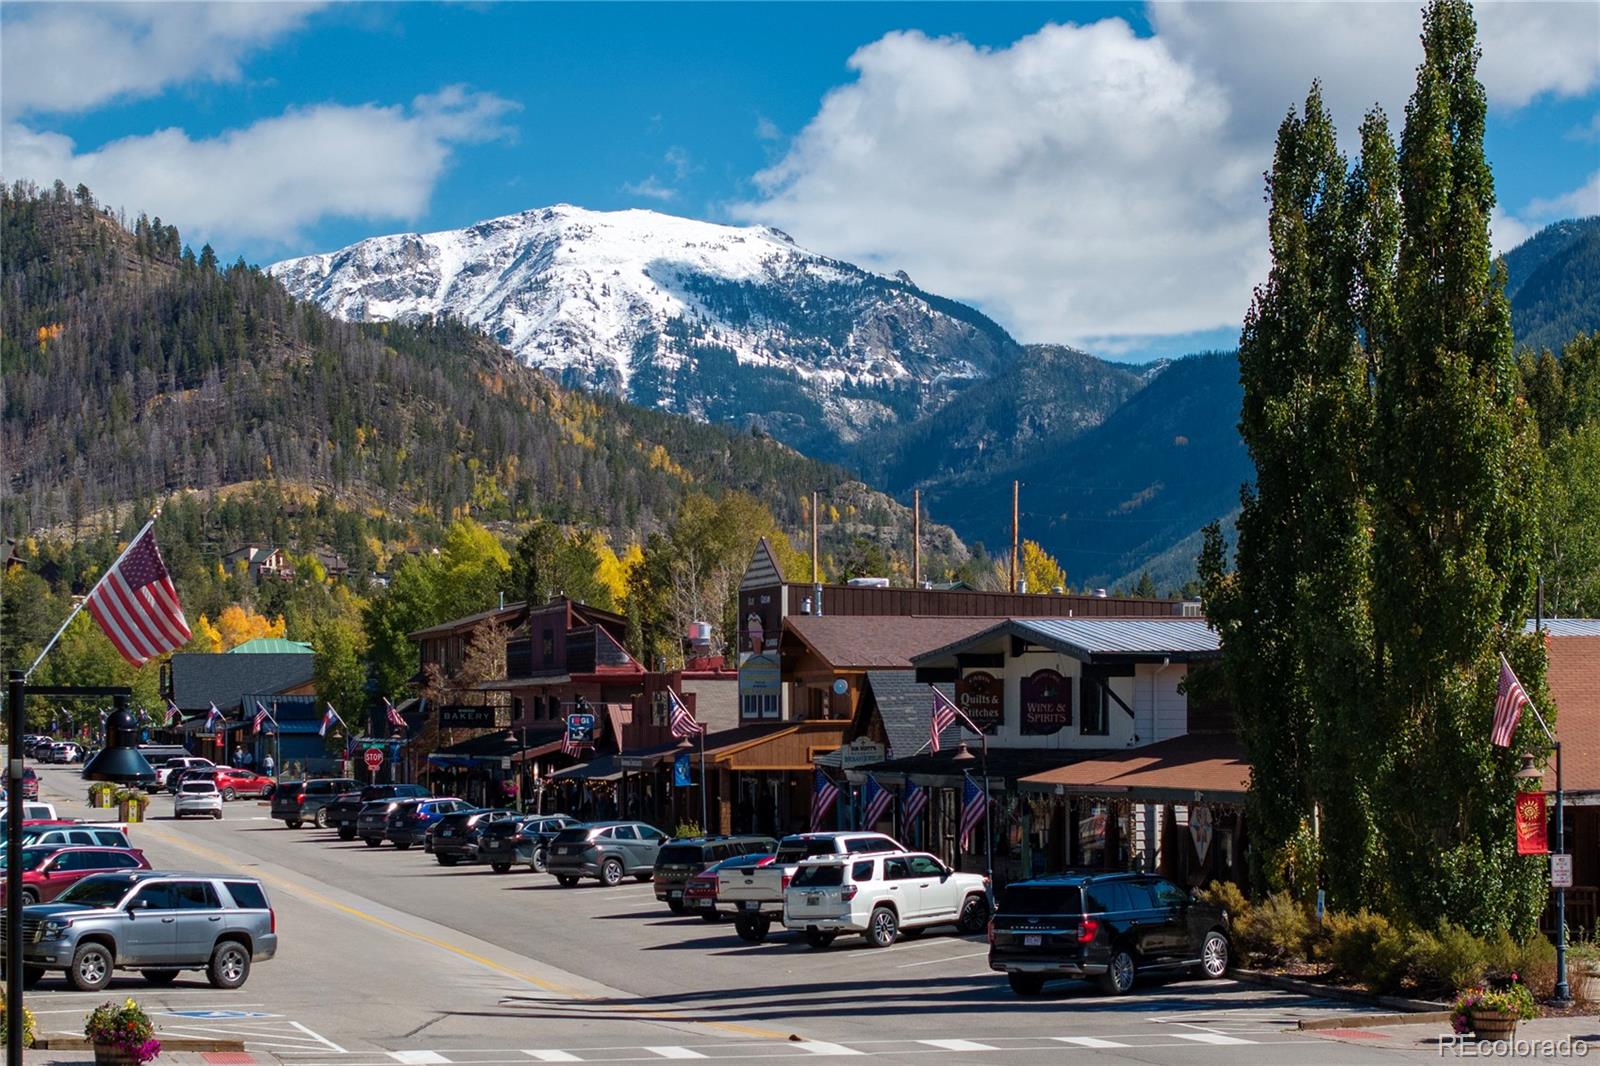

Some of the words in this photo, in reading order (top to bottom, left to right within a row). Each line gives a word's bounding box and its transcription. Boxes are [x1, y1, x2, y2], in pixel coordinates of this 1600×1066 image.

[961, 693, 990, 706] Quilts
[991, 695, 1000, 704] &
[962, 706, 999, 717] Stitches
[1026, 703, 1055, 712] WINE
[1056, 703, 1066, 712] &
[443, 712, 489, 720] BAKERY
[1026, 712, 1066, 723] SPIRITS
[366, 753, 381, 761] STOP
